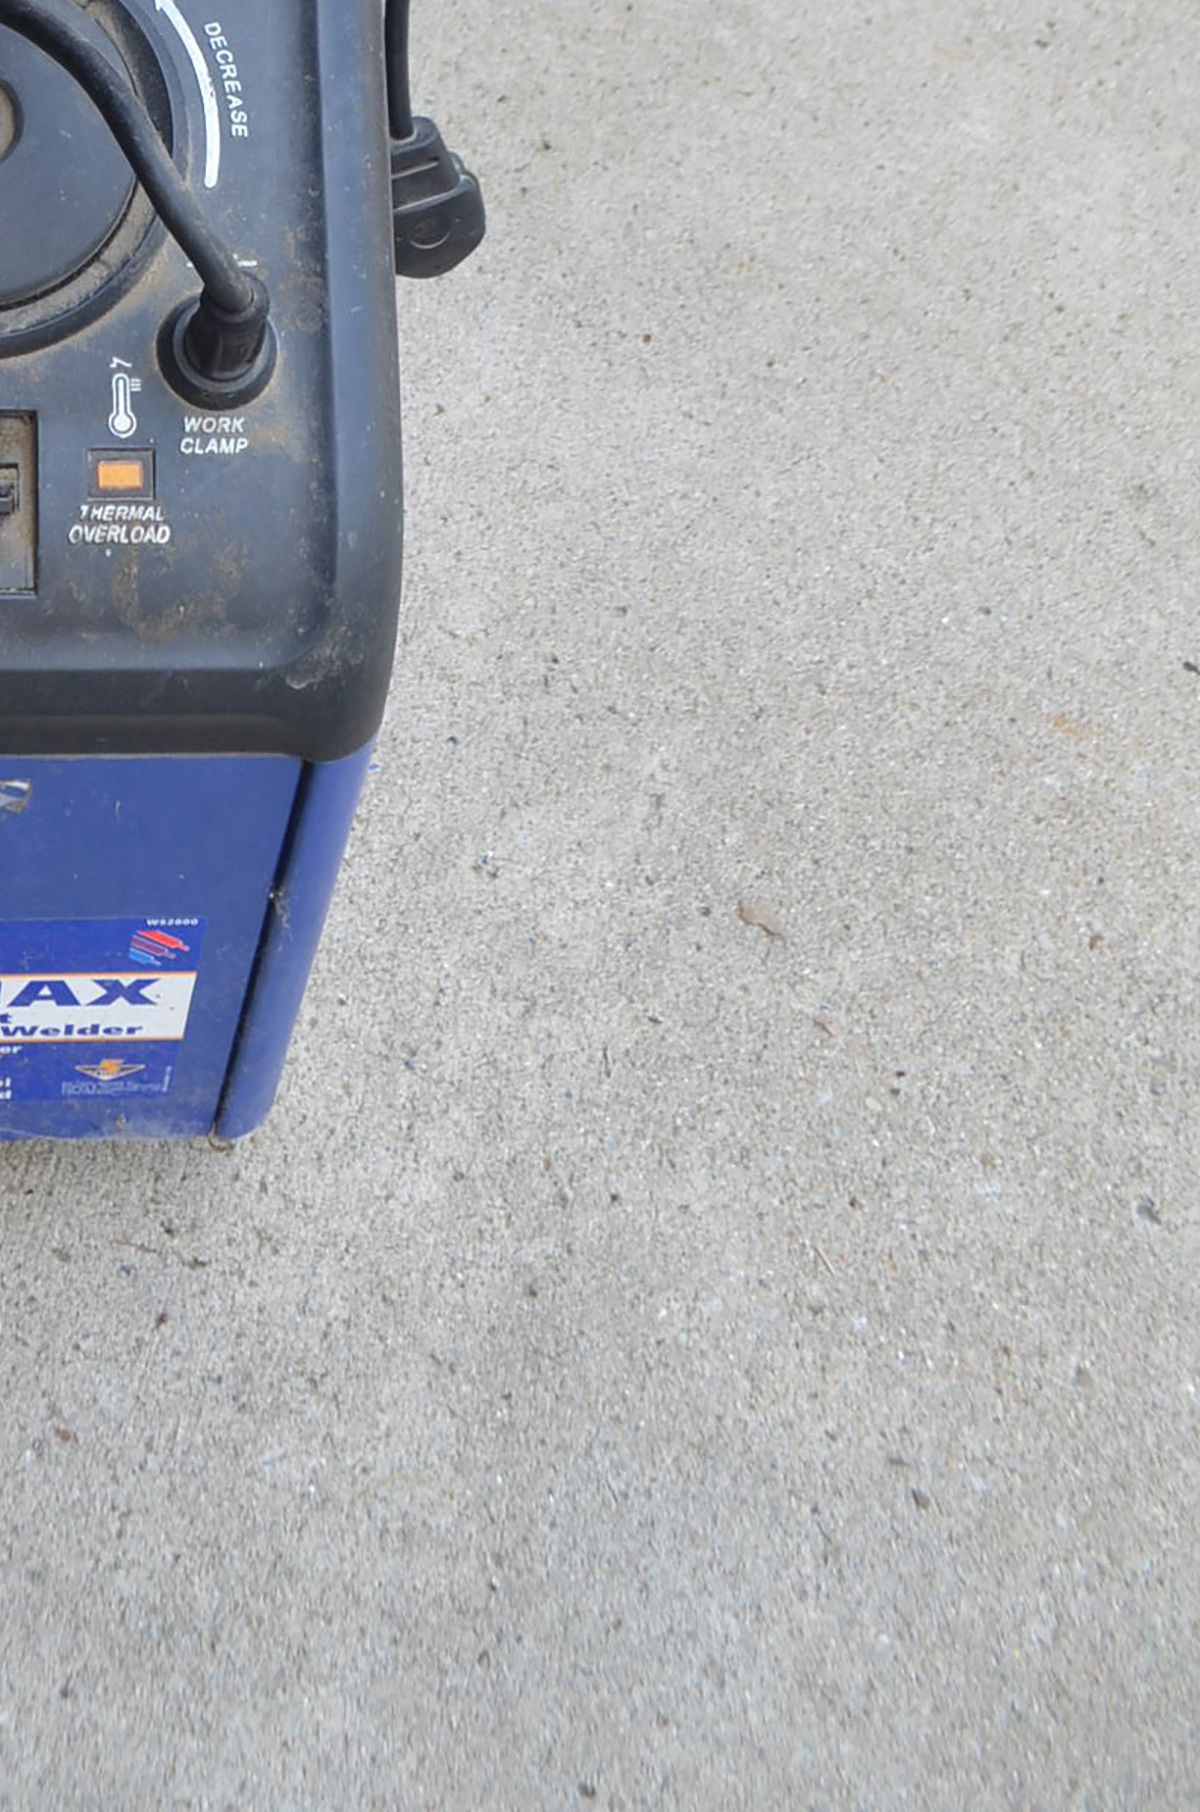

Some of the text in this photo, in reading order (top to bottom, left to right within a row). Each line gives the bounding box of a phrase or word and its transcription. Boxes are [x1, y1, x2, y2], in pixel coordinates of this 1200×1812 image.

[204, 22, 248, 138] DECREASE
[183, 416, 245, 433] WORK
[180, 437, 248, 454] CLAMP
[80, 505, 165, 522] THERMAL
[69, 525, 171, 544] OVERLOAD
[0, 1022, 143, 1037] Welder
